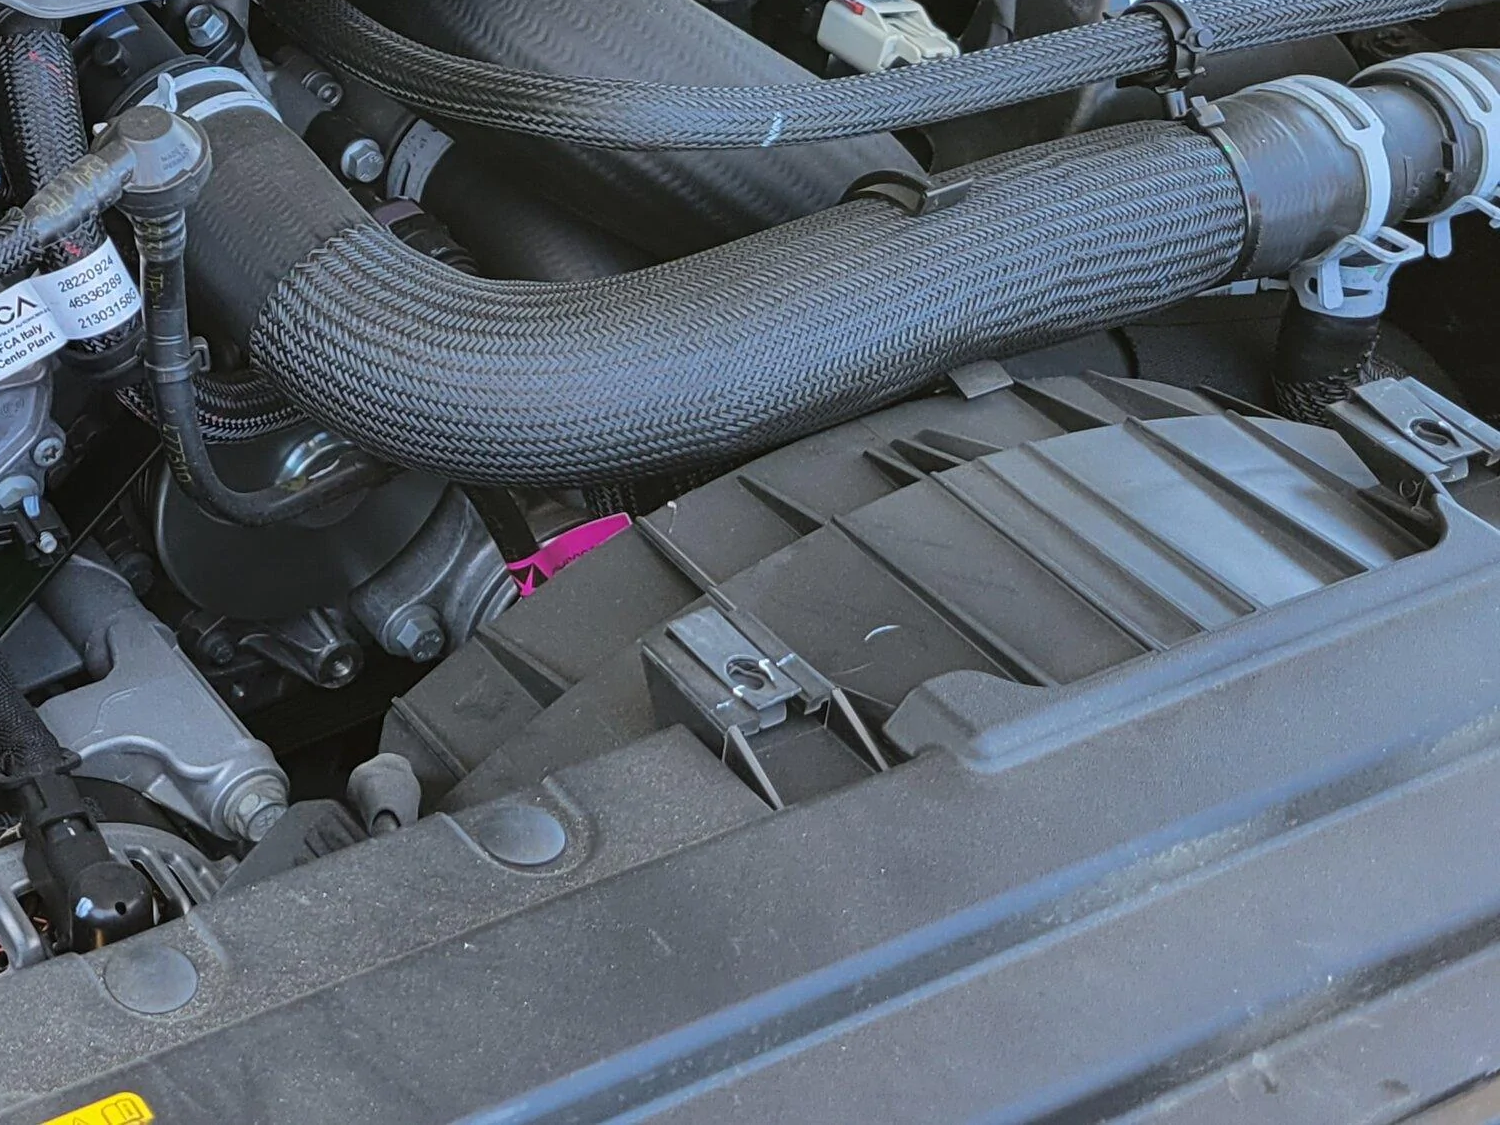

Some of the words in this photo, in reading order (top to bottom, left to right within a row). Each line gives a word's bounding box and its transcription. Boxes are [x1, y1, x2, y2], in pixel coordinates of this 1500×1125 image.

[58, 255, 113, 292] 28220924
[68, 273, 122, 309] 46336289
[21, 323, 43, 342] Italy
[28, 332, 56, 354] Plant
